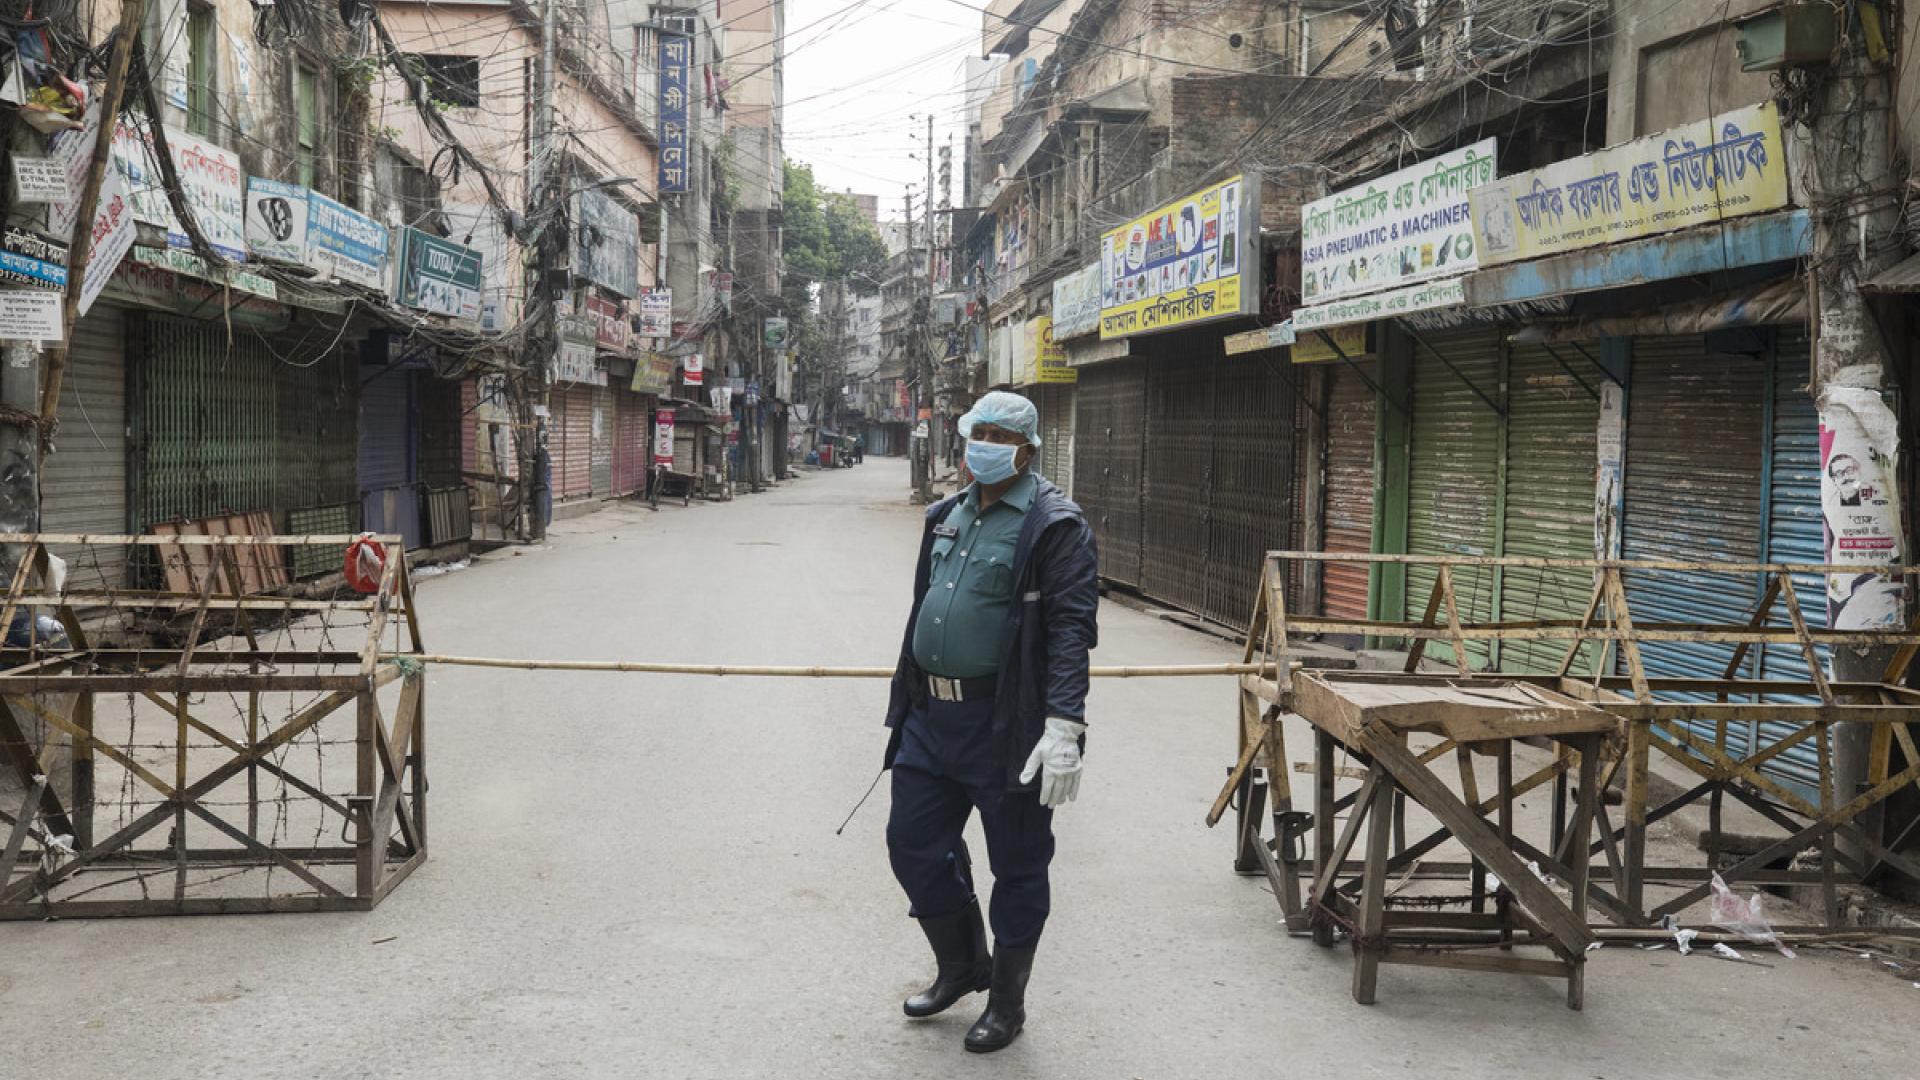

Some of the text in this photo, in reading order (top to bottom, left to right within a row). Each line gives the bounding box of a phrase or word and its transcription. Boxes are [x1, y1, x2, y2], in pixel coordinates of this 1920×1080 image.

[1516, 178, 1564, 231] আশিক
[1303, 202, 1471, 264] ASIA PNEUMATIC & MACHINER
[1103, 310, 1137, 332] আমান
[1142, 286, 1216, 328] মেশিনারীজ
